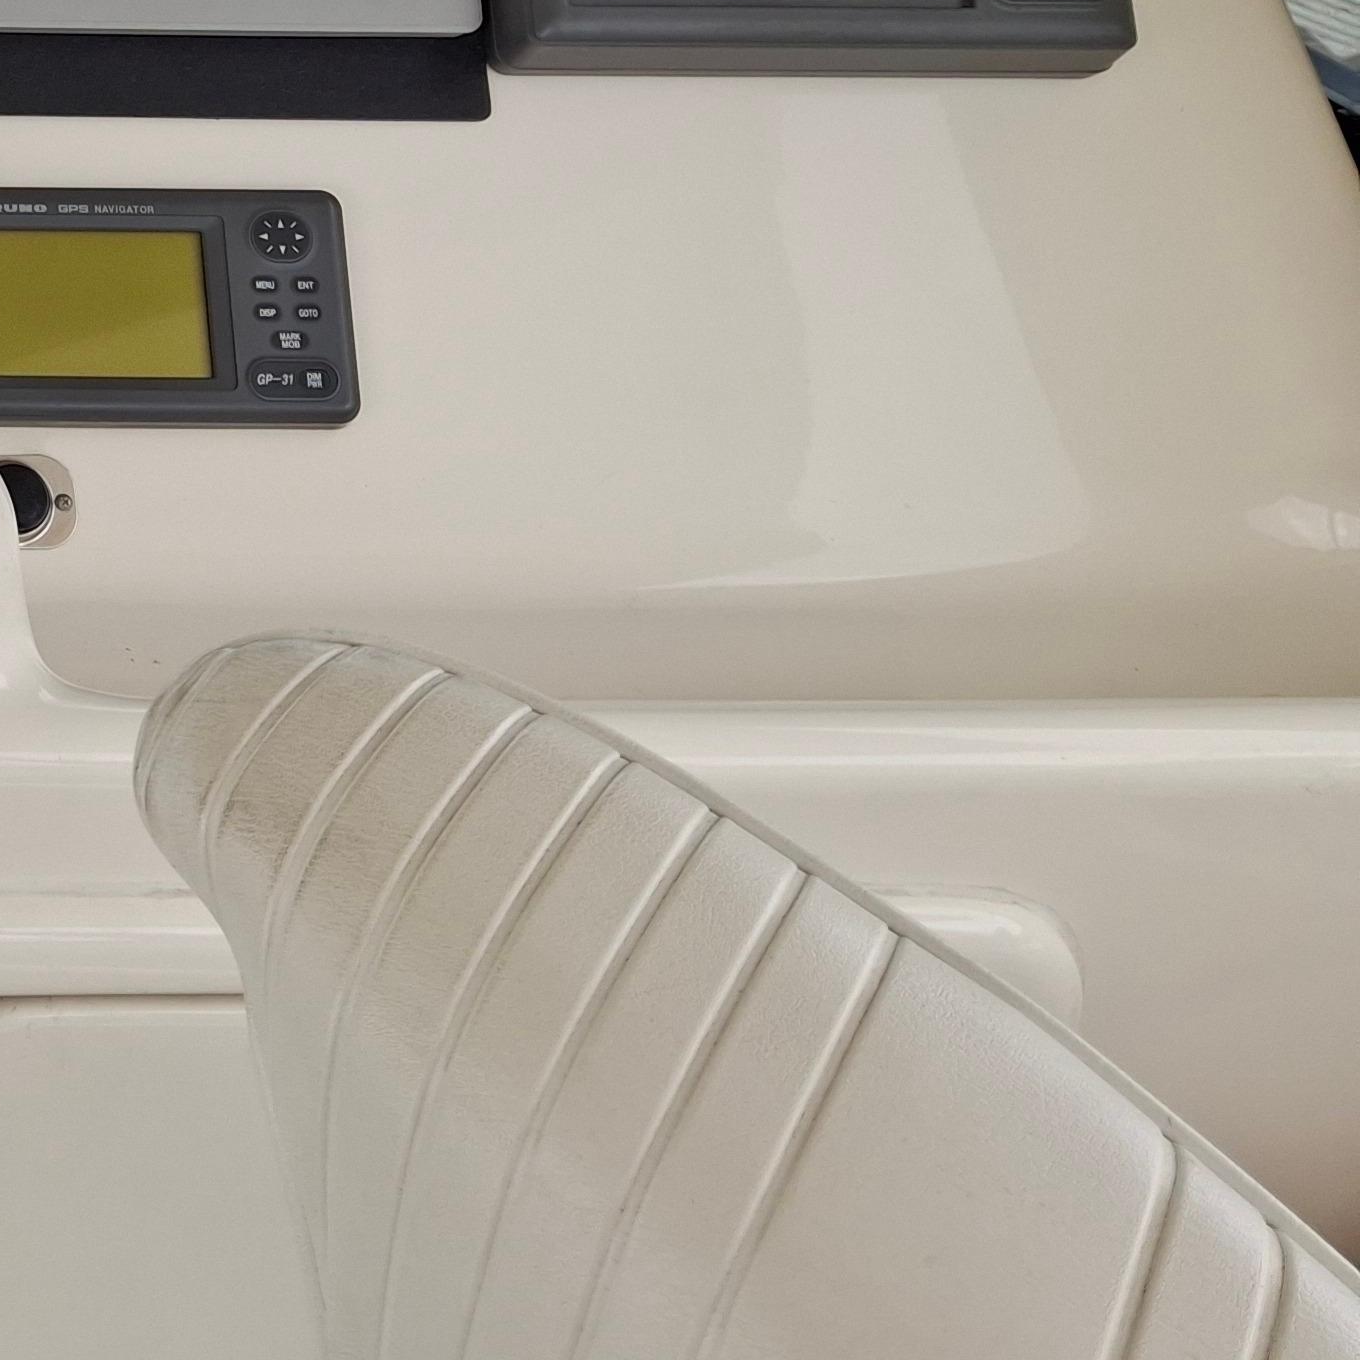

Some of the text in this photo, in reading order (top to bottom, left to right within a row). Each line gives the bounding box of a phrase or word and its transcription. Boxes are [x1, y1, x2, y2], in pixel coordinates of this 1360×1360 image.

[58, 204, 89, 214] GPS
[94, 204, 155, 214] NAVIGATOR
[255, 280, 275, 290] MENU
[297, 280, 314, 290] ENT
[259, 308, 277, 317] DISP
[298, 309, 319, 318] GOTO
[279, 332, 301, 341] MARK
[281, 340, 300, 349] MOB
[257, 373, 294, 386] GP-31
